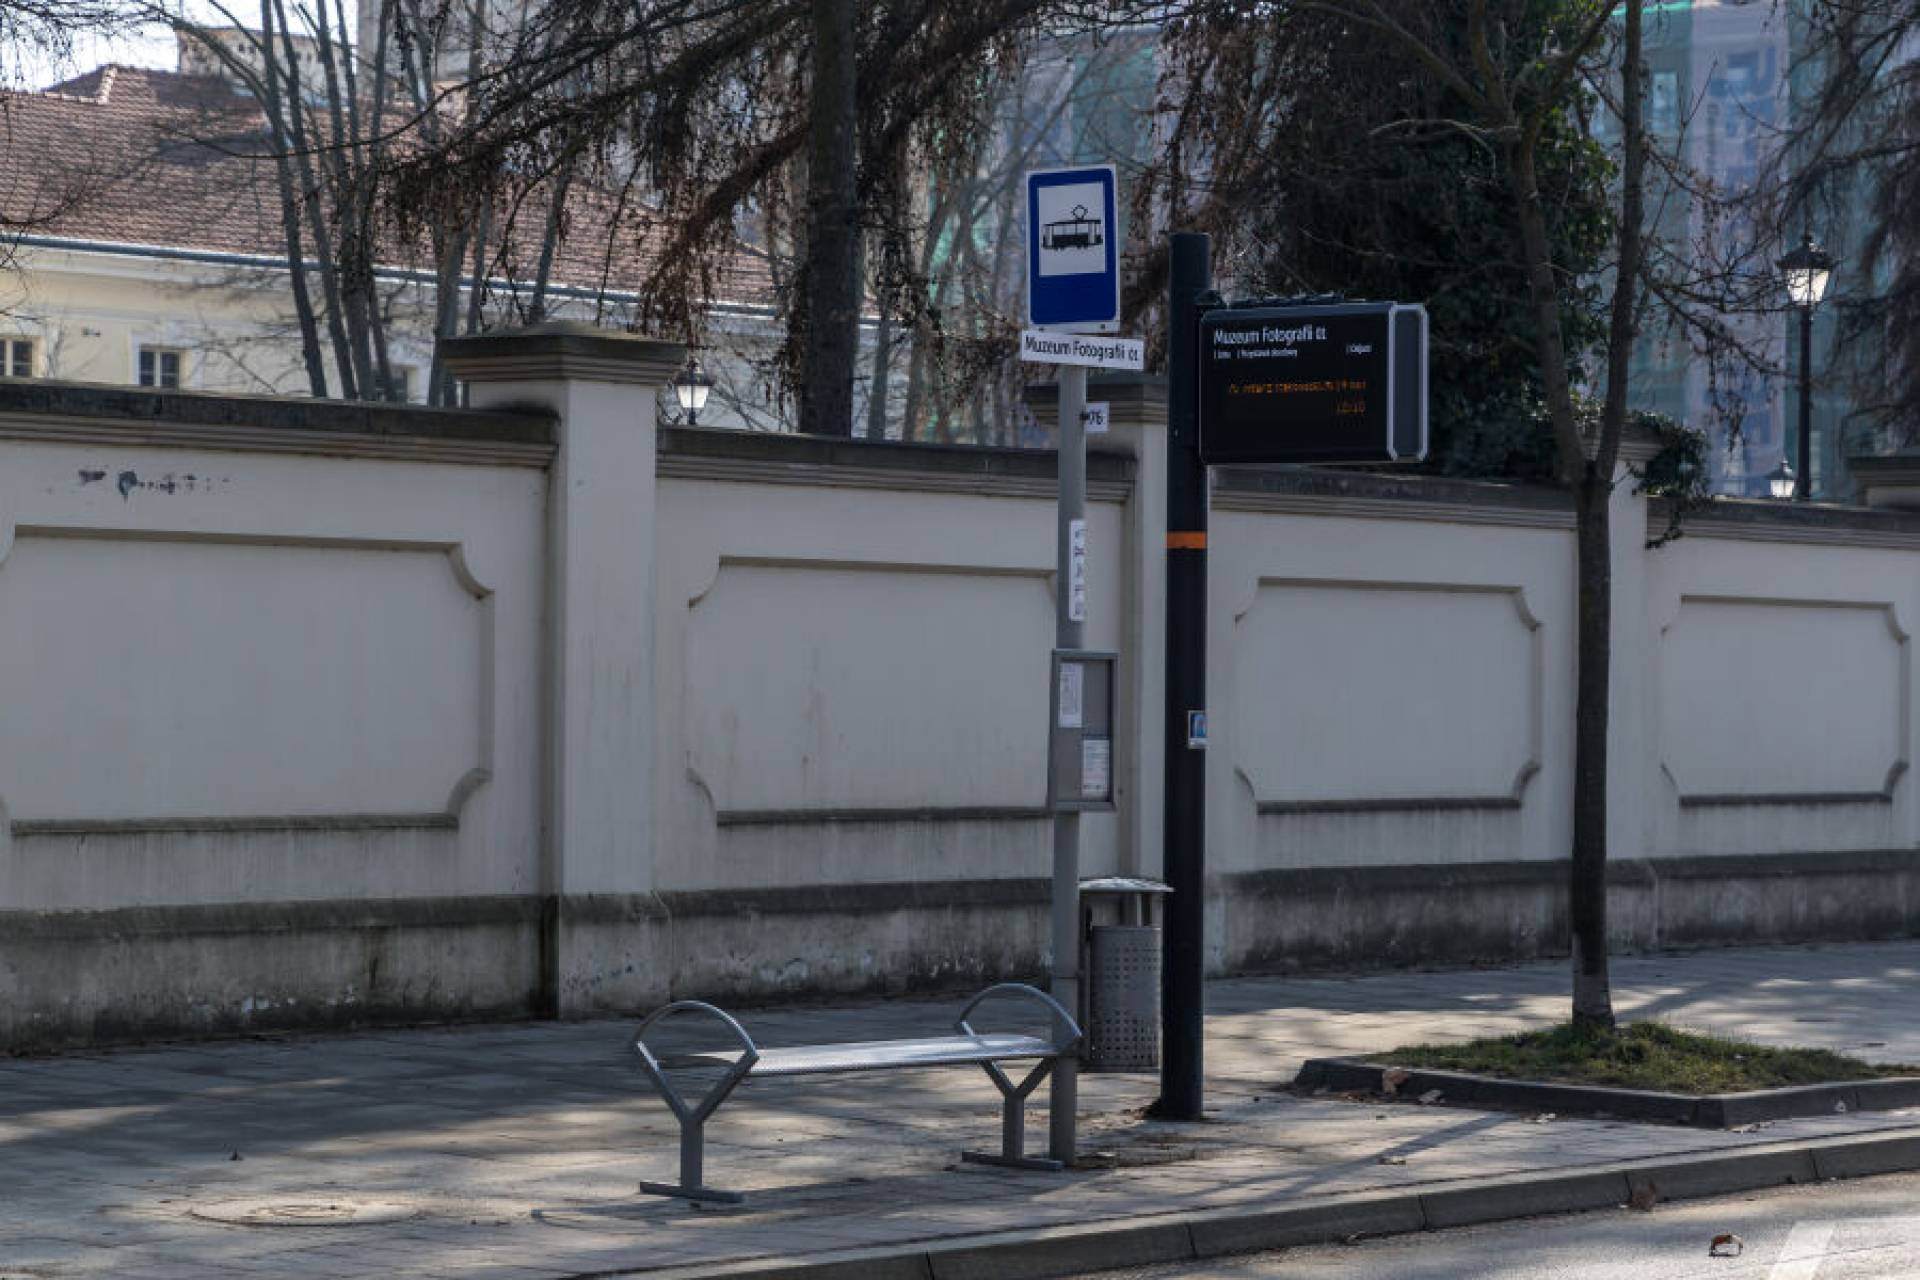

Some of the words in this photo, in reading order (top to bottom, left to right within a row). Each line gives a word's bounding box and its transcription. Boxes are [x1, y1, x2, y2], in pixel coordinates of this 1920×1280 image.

[1214, 329, 1260, 344] Muzeum
[1026, 336, 1071, 355] Muzeum
[1073, 340, 1125, 362] Fotografii
